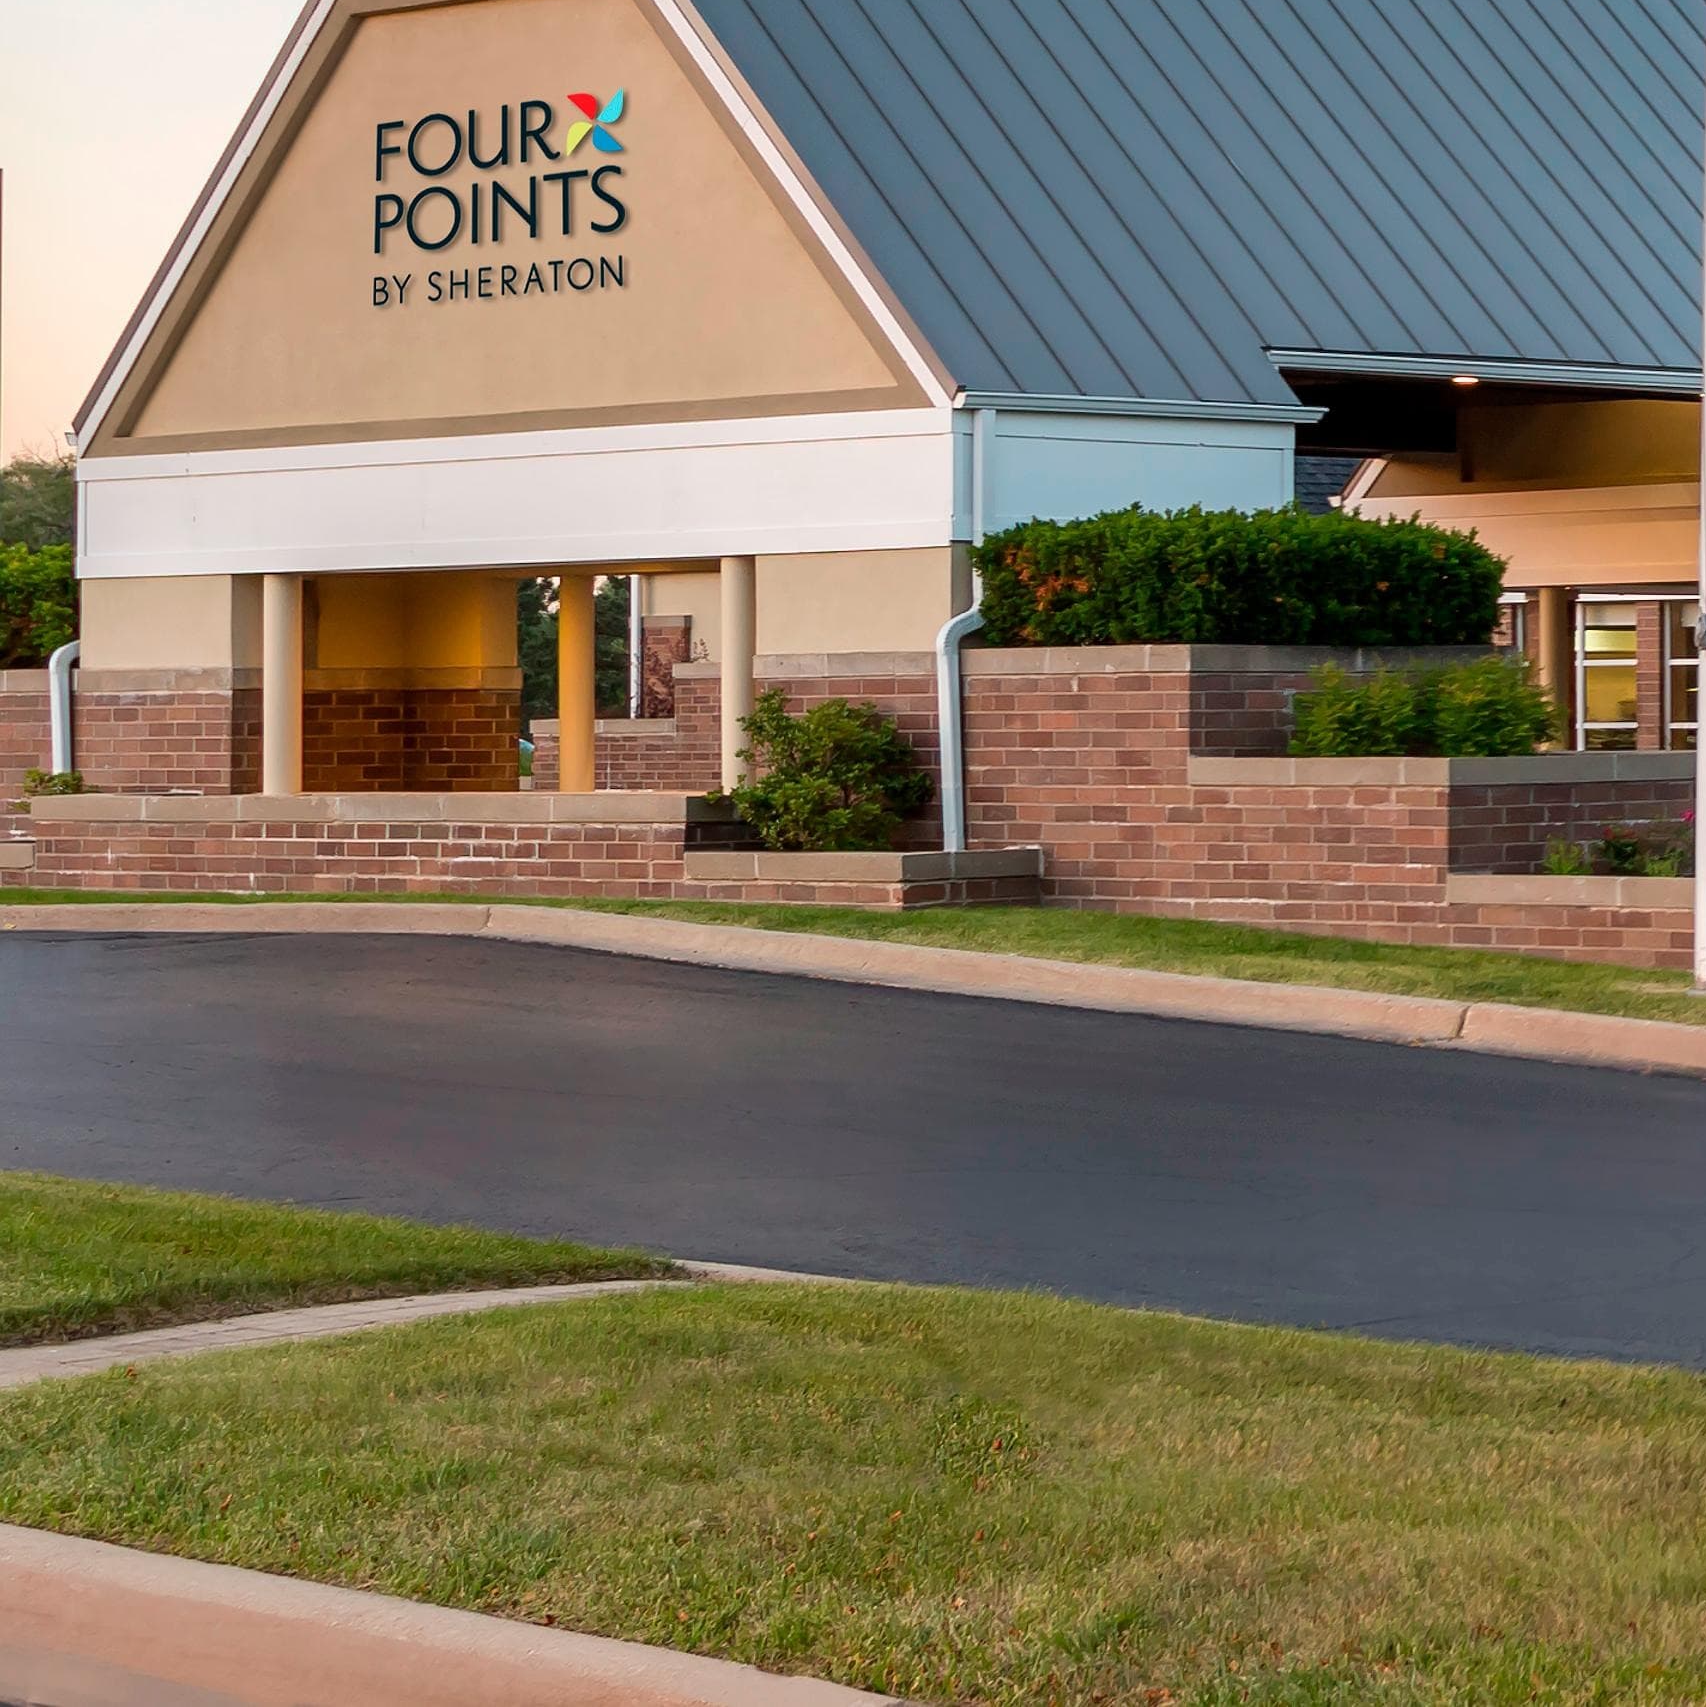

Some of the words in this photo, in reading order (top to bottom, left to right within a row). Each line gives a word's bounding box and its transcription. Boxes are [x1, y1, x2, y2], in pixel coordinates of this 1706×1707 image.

[375, 99, 561, 182] FOUR
[373, 164, 627, 254] POINTS
[372, 273, 412, 306] BY
[427, 254, 624, 302] SHERATON
